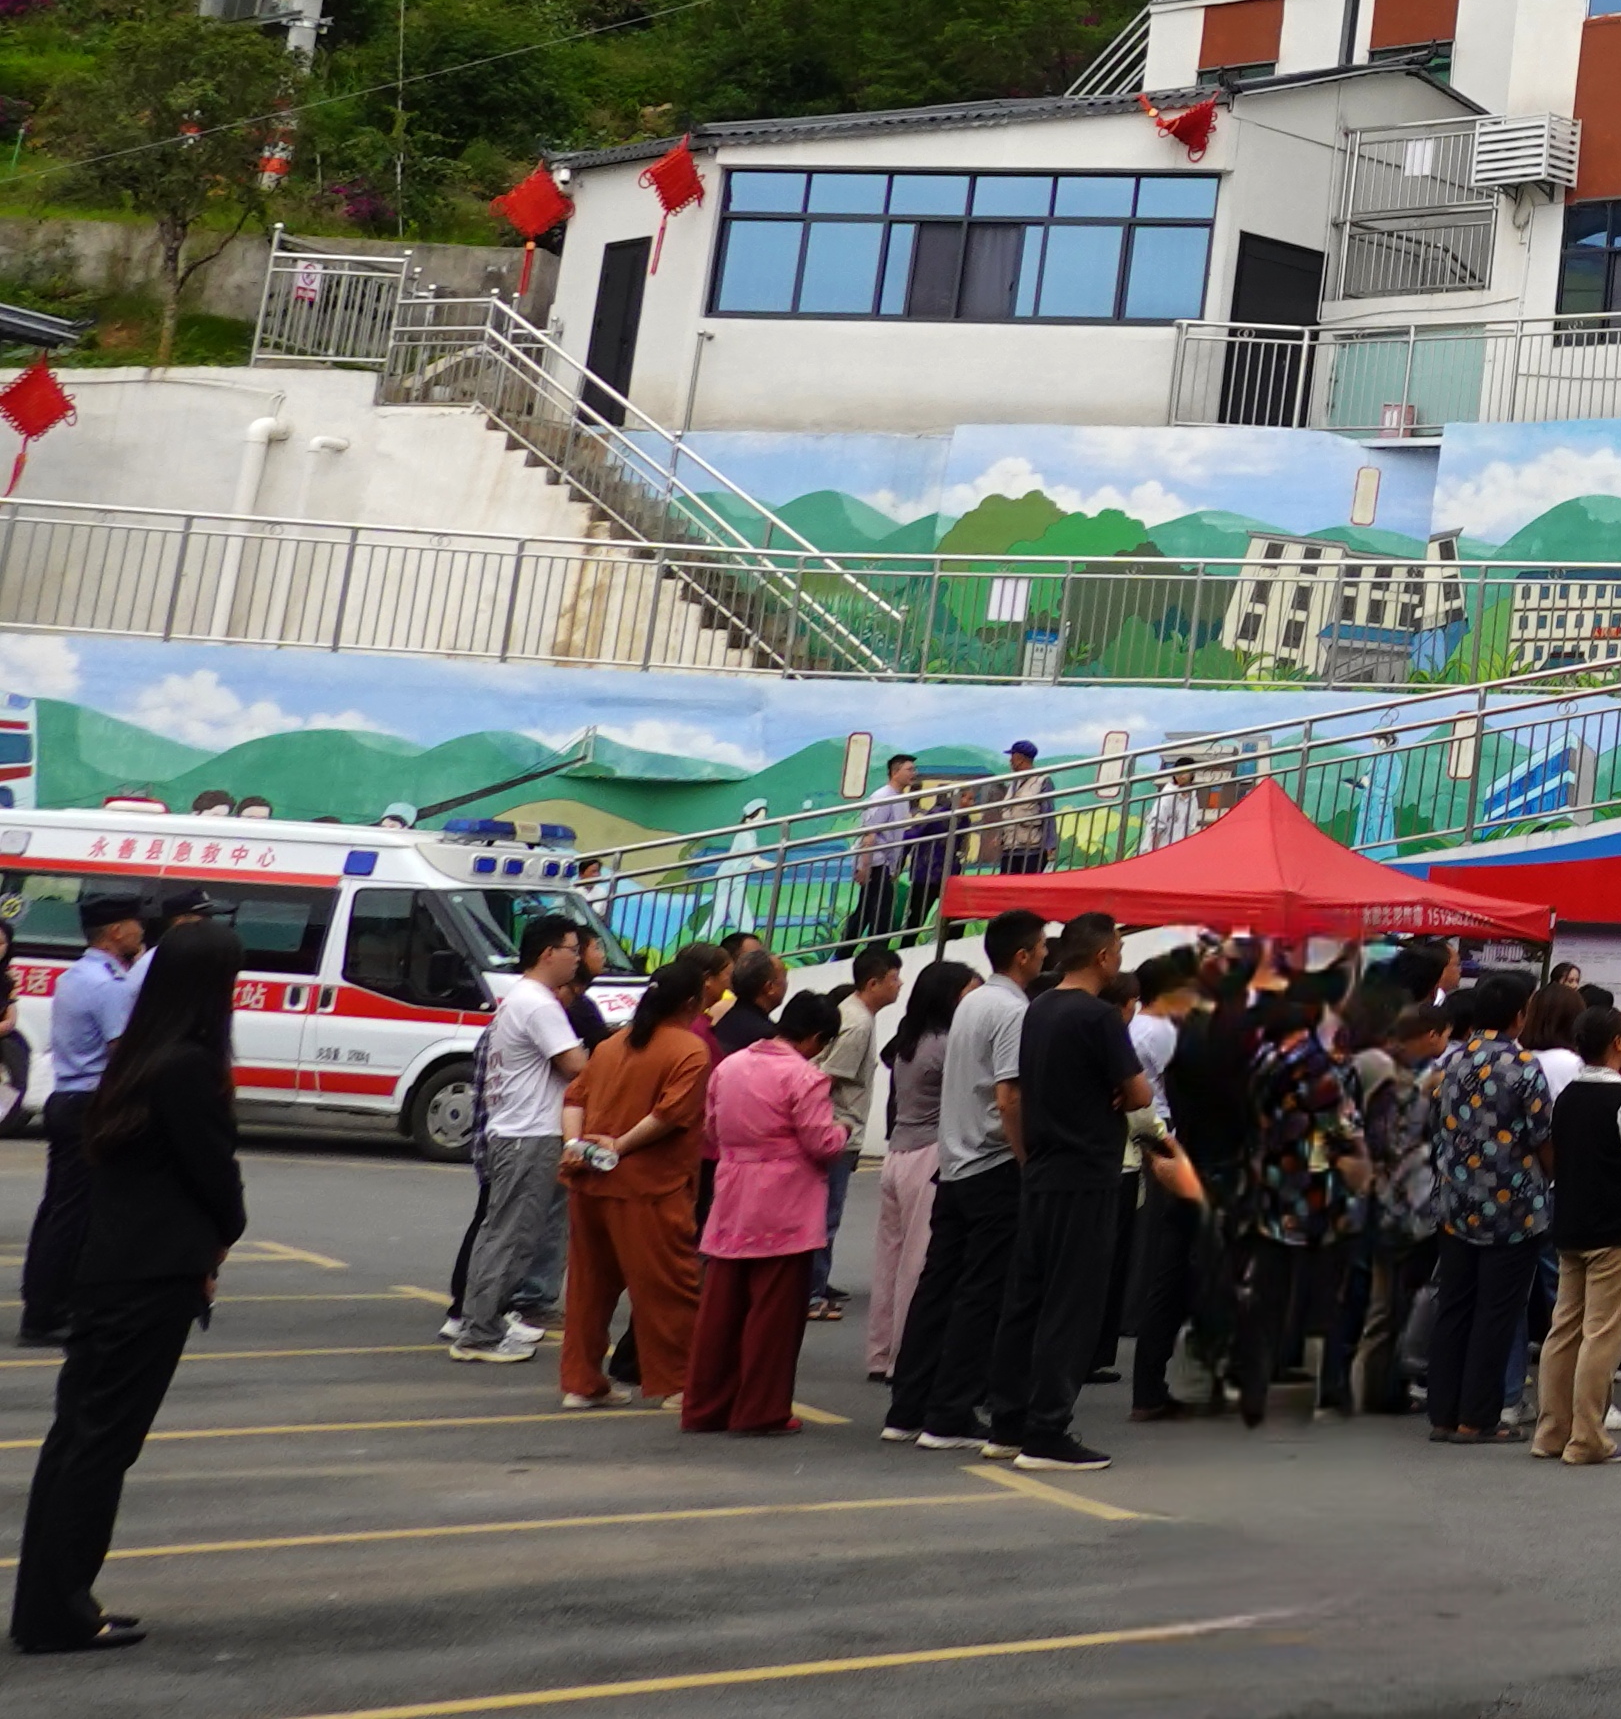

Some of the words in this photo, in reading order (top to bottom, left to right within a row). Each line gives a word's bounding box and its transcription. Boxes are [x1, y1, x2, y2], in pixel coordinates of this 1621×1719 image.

[87, 836, 276, 868] 永善县急救中心
